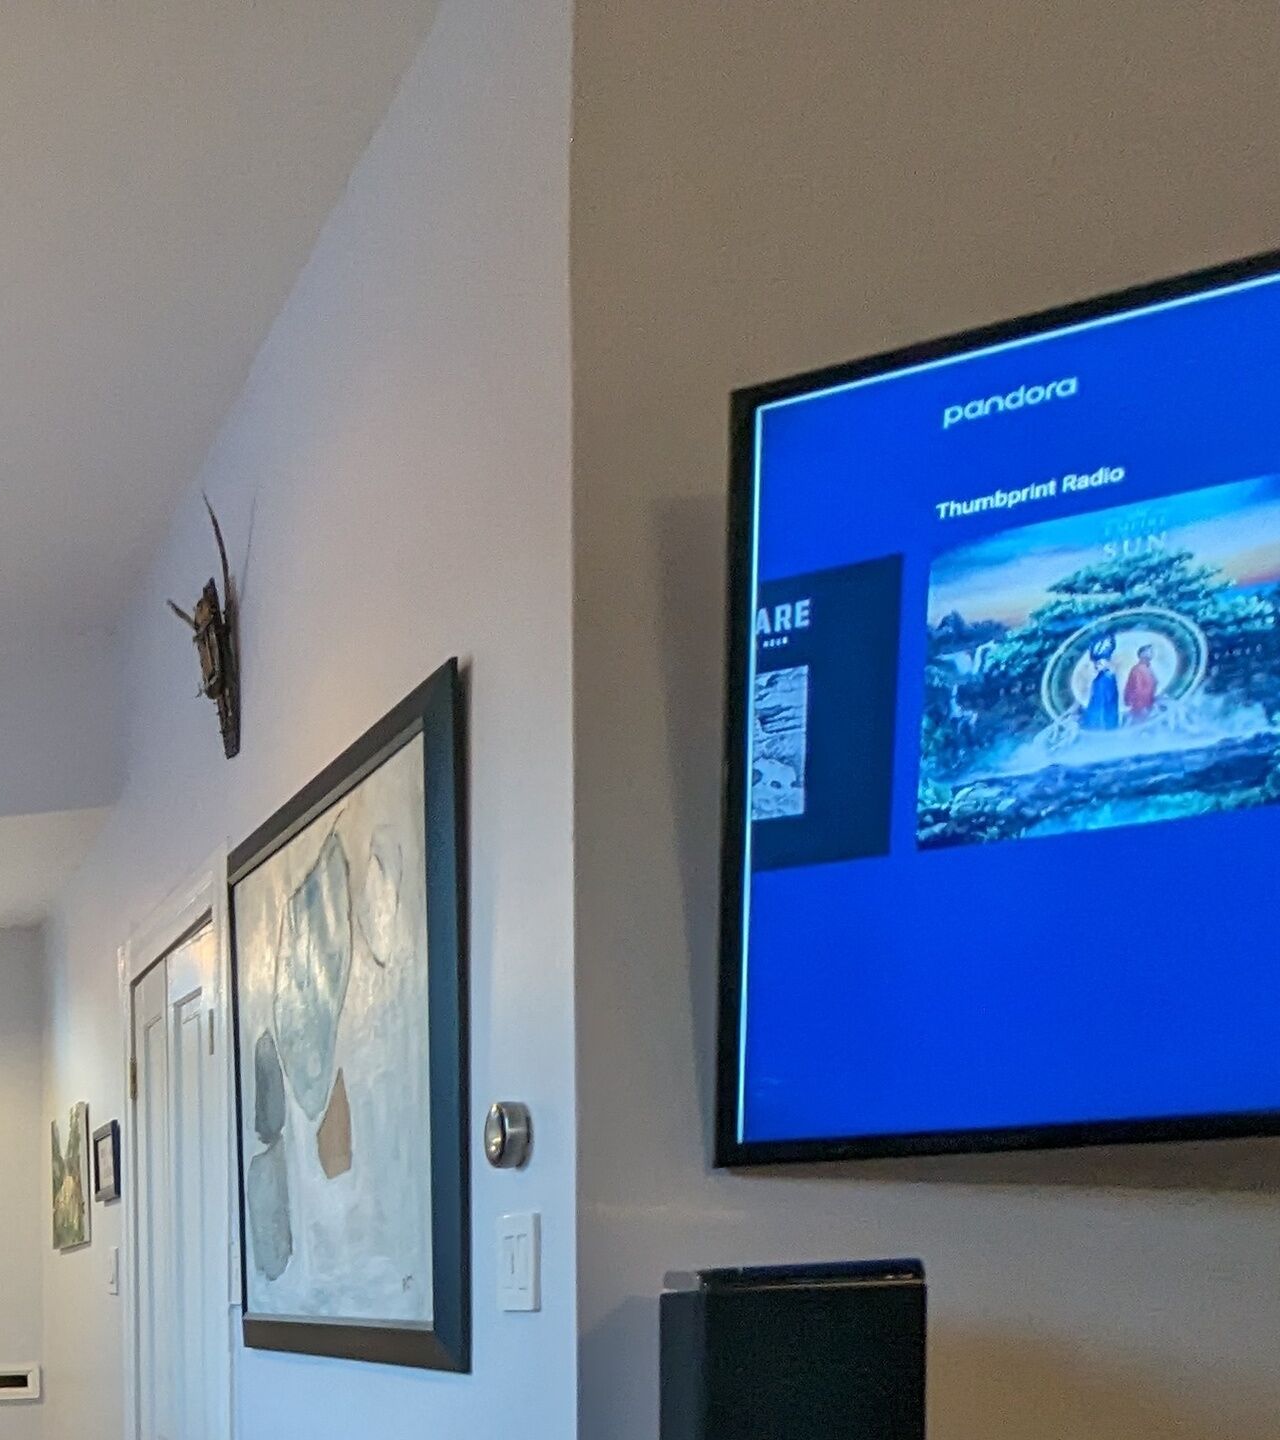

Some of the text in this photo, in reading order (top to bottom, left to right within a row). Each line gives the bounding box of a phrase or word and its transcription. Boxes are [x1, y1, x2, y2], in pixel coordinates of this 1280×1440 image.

[943, 376, 1078, 430] pandora
[935, 466, 1126, 520] Thumbprint Radio
[755, 598, 811, 635] ARE
